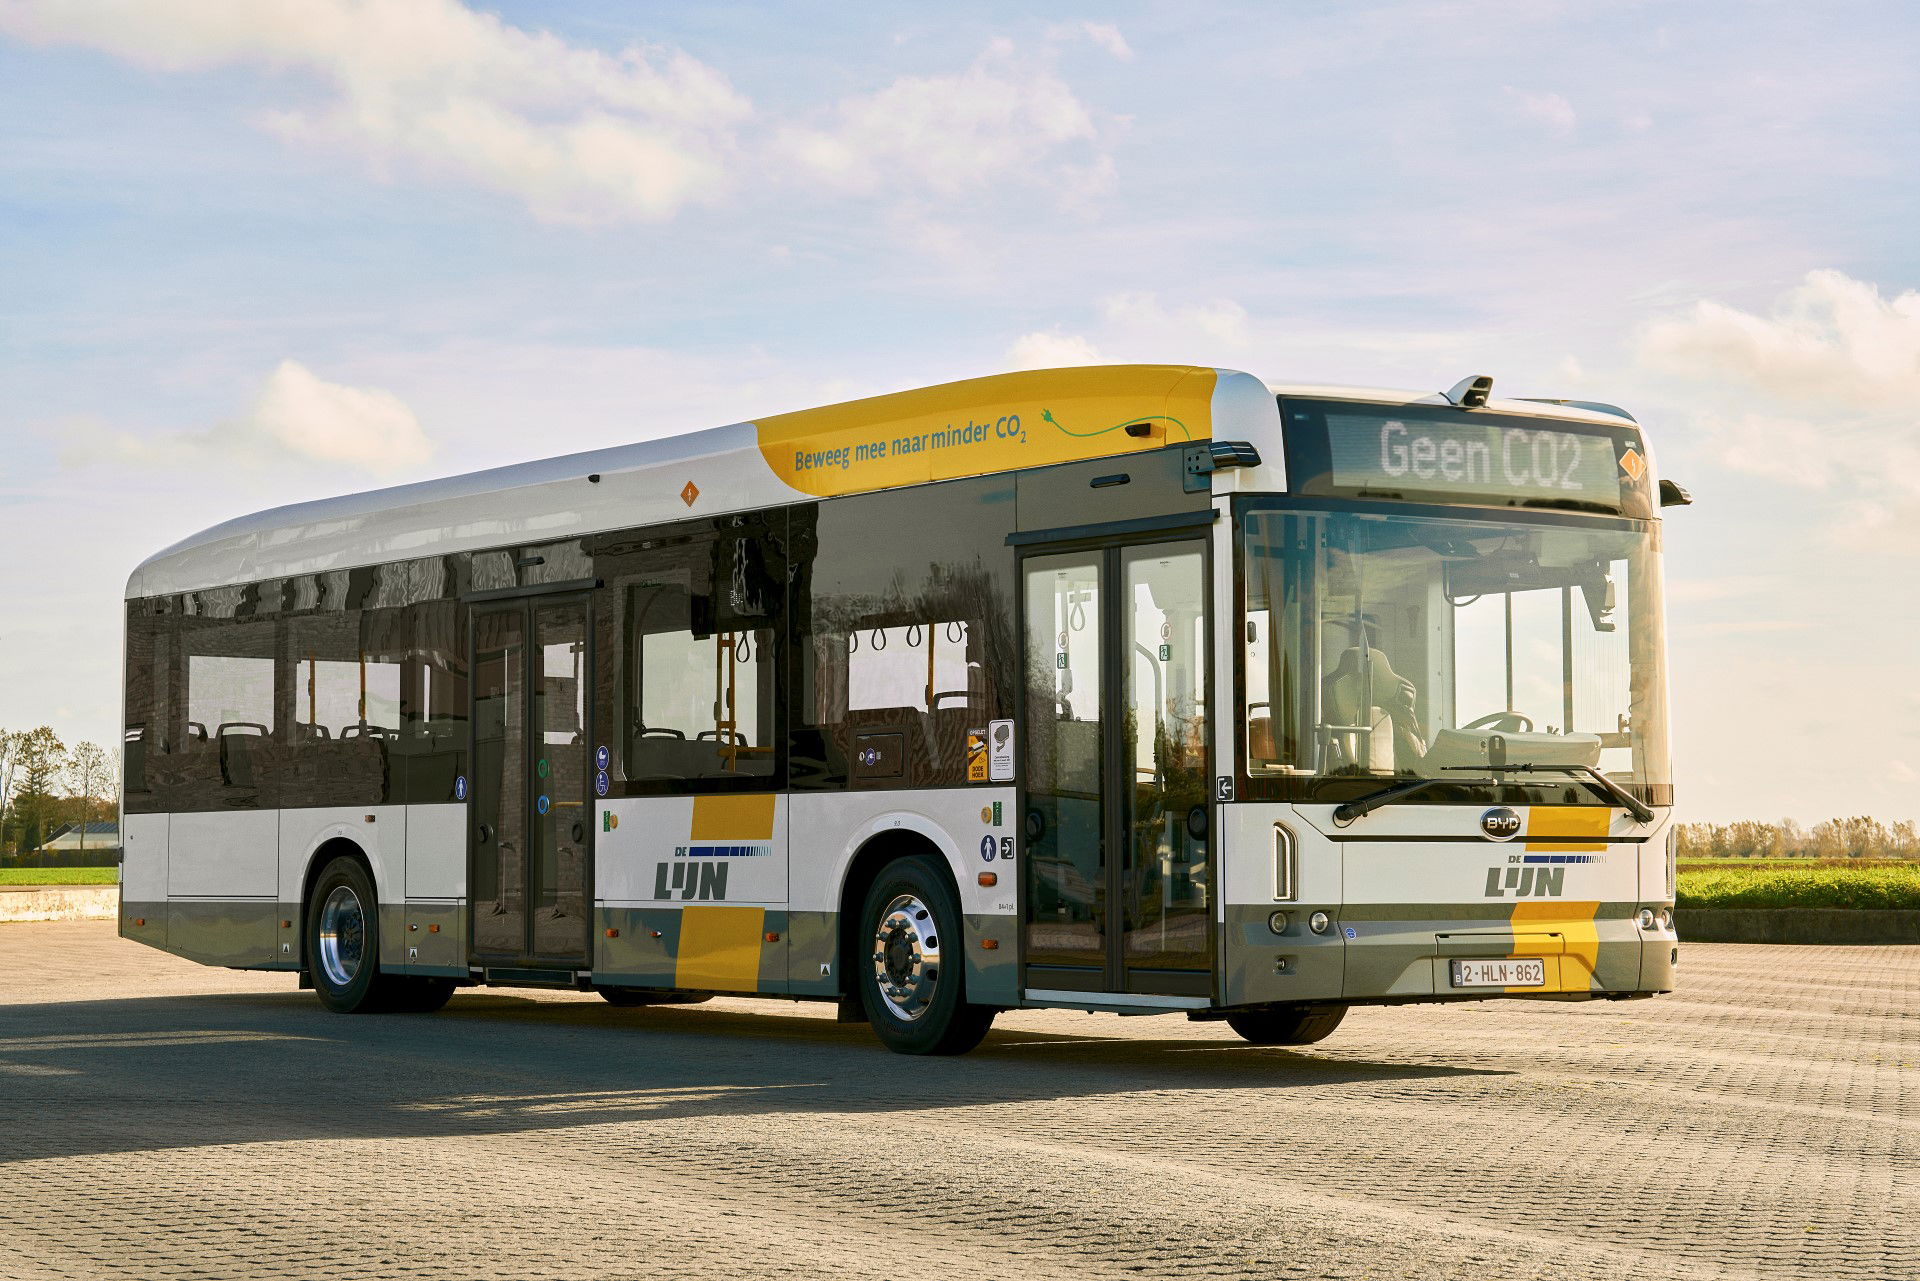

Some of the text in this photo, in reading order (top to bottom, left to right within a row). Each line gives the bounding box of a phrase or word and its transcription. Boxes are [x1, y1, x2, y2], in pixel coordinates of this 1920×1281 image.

[795, 446, 850, 472] Beweeg
[855, 441, 887, 462] mee
[892, 433, 929, 456] naar
[931, 420, 991, 449] minder
[1381, 420, 1584, 490] Geen CO2
[1487, 817, 1519, 830] BYD
[674, 846, 688, 857] DE
[1508, 855, 1522, 864] DE
[654, 861, 729, 900] LIJN
[1485, 867, 1565, 897] LIJN
[1455, 964, 1541, 983] B 2-HLN-862
